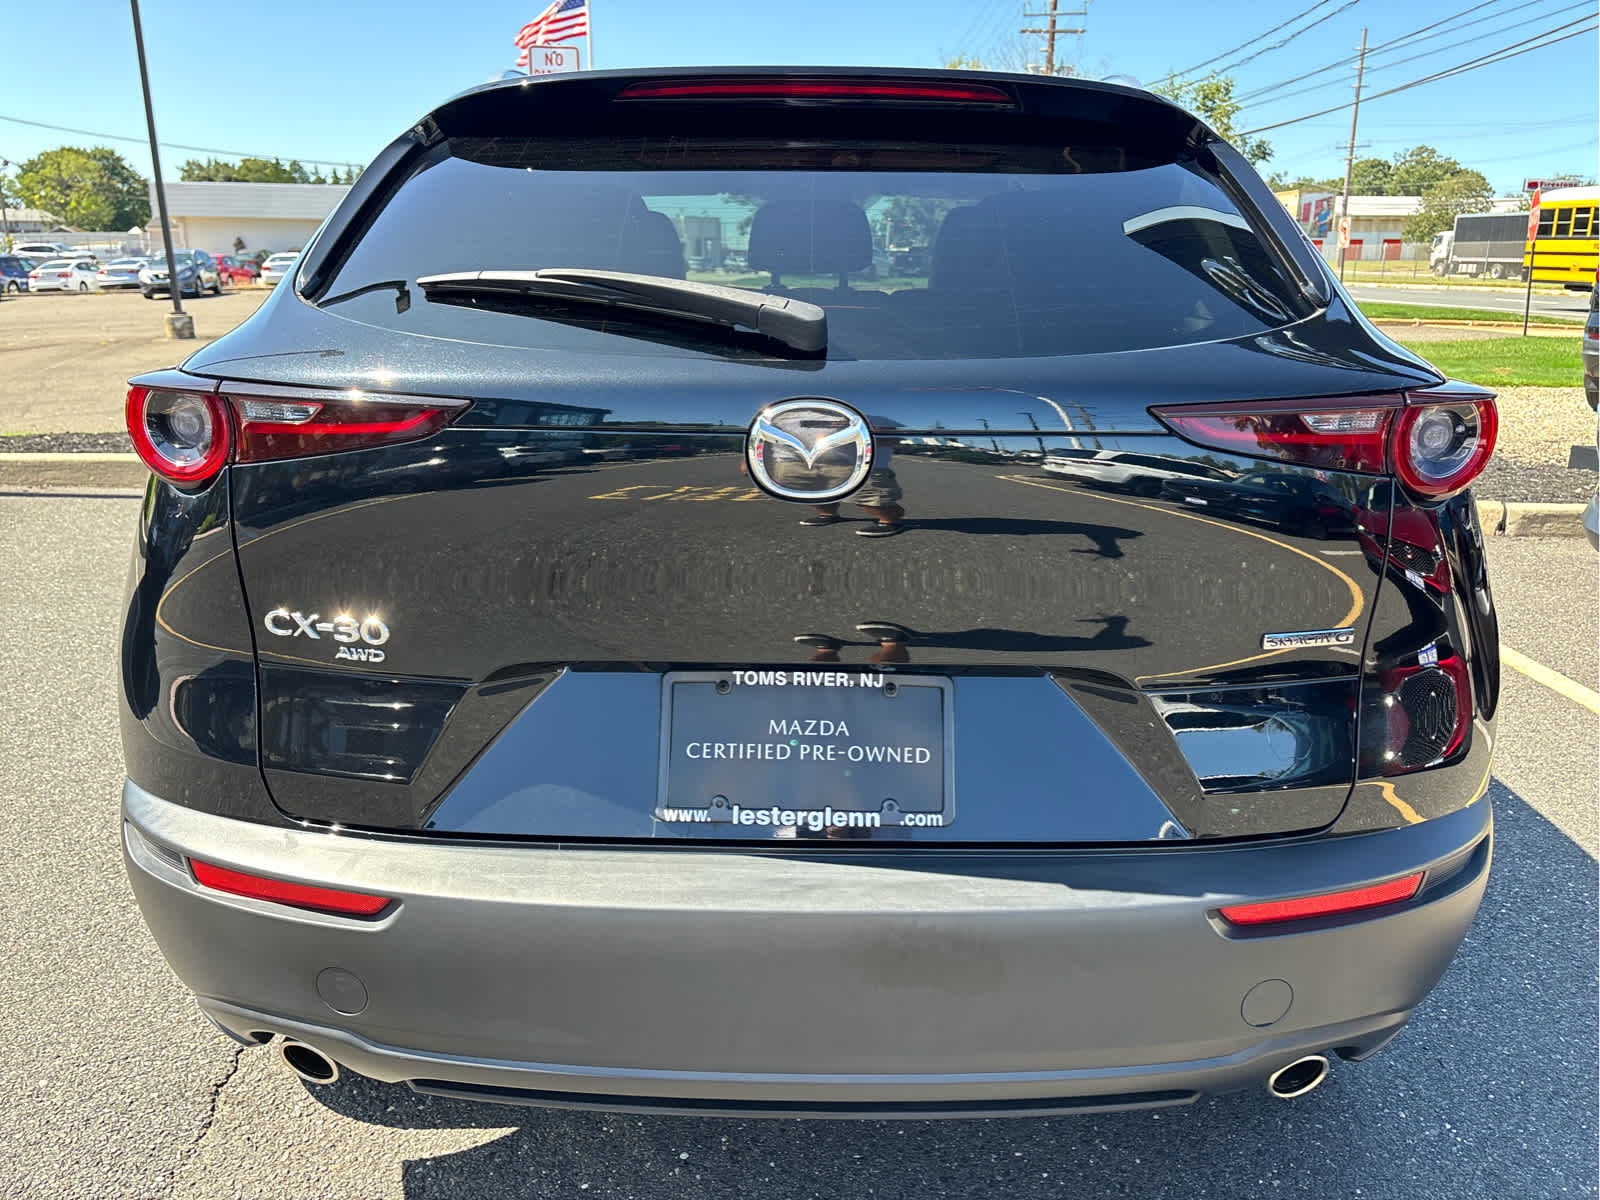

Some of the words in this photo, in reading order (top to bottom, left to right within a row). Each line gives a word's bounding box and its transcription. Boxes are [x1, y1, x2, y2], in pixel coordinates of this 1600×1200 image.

[544, 52, 564, 66] NO
[264, 609, 390, 645] CX-30
[335, 646, 385, 663] AWD
[732, 671, 787, 686] TOMS
[793, 671, 854, 688] RIVER,
[860, 673, 884, 688] NJ
[768, 719, 850, 737] MAZDA
[686, 742, 791, 760] CERTIFIED
[799, 744, 931, 764] PRE-OWNED
[663, 808, 712, 823] www.
[732, 805, 881, 832] lesterglenn
[900, 812, 943, 827] .com
